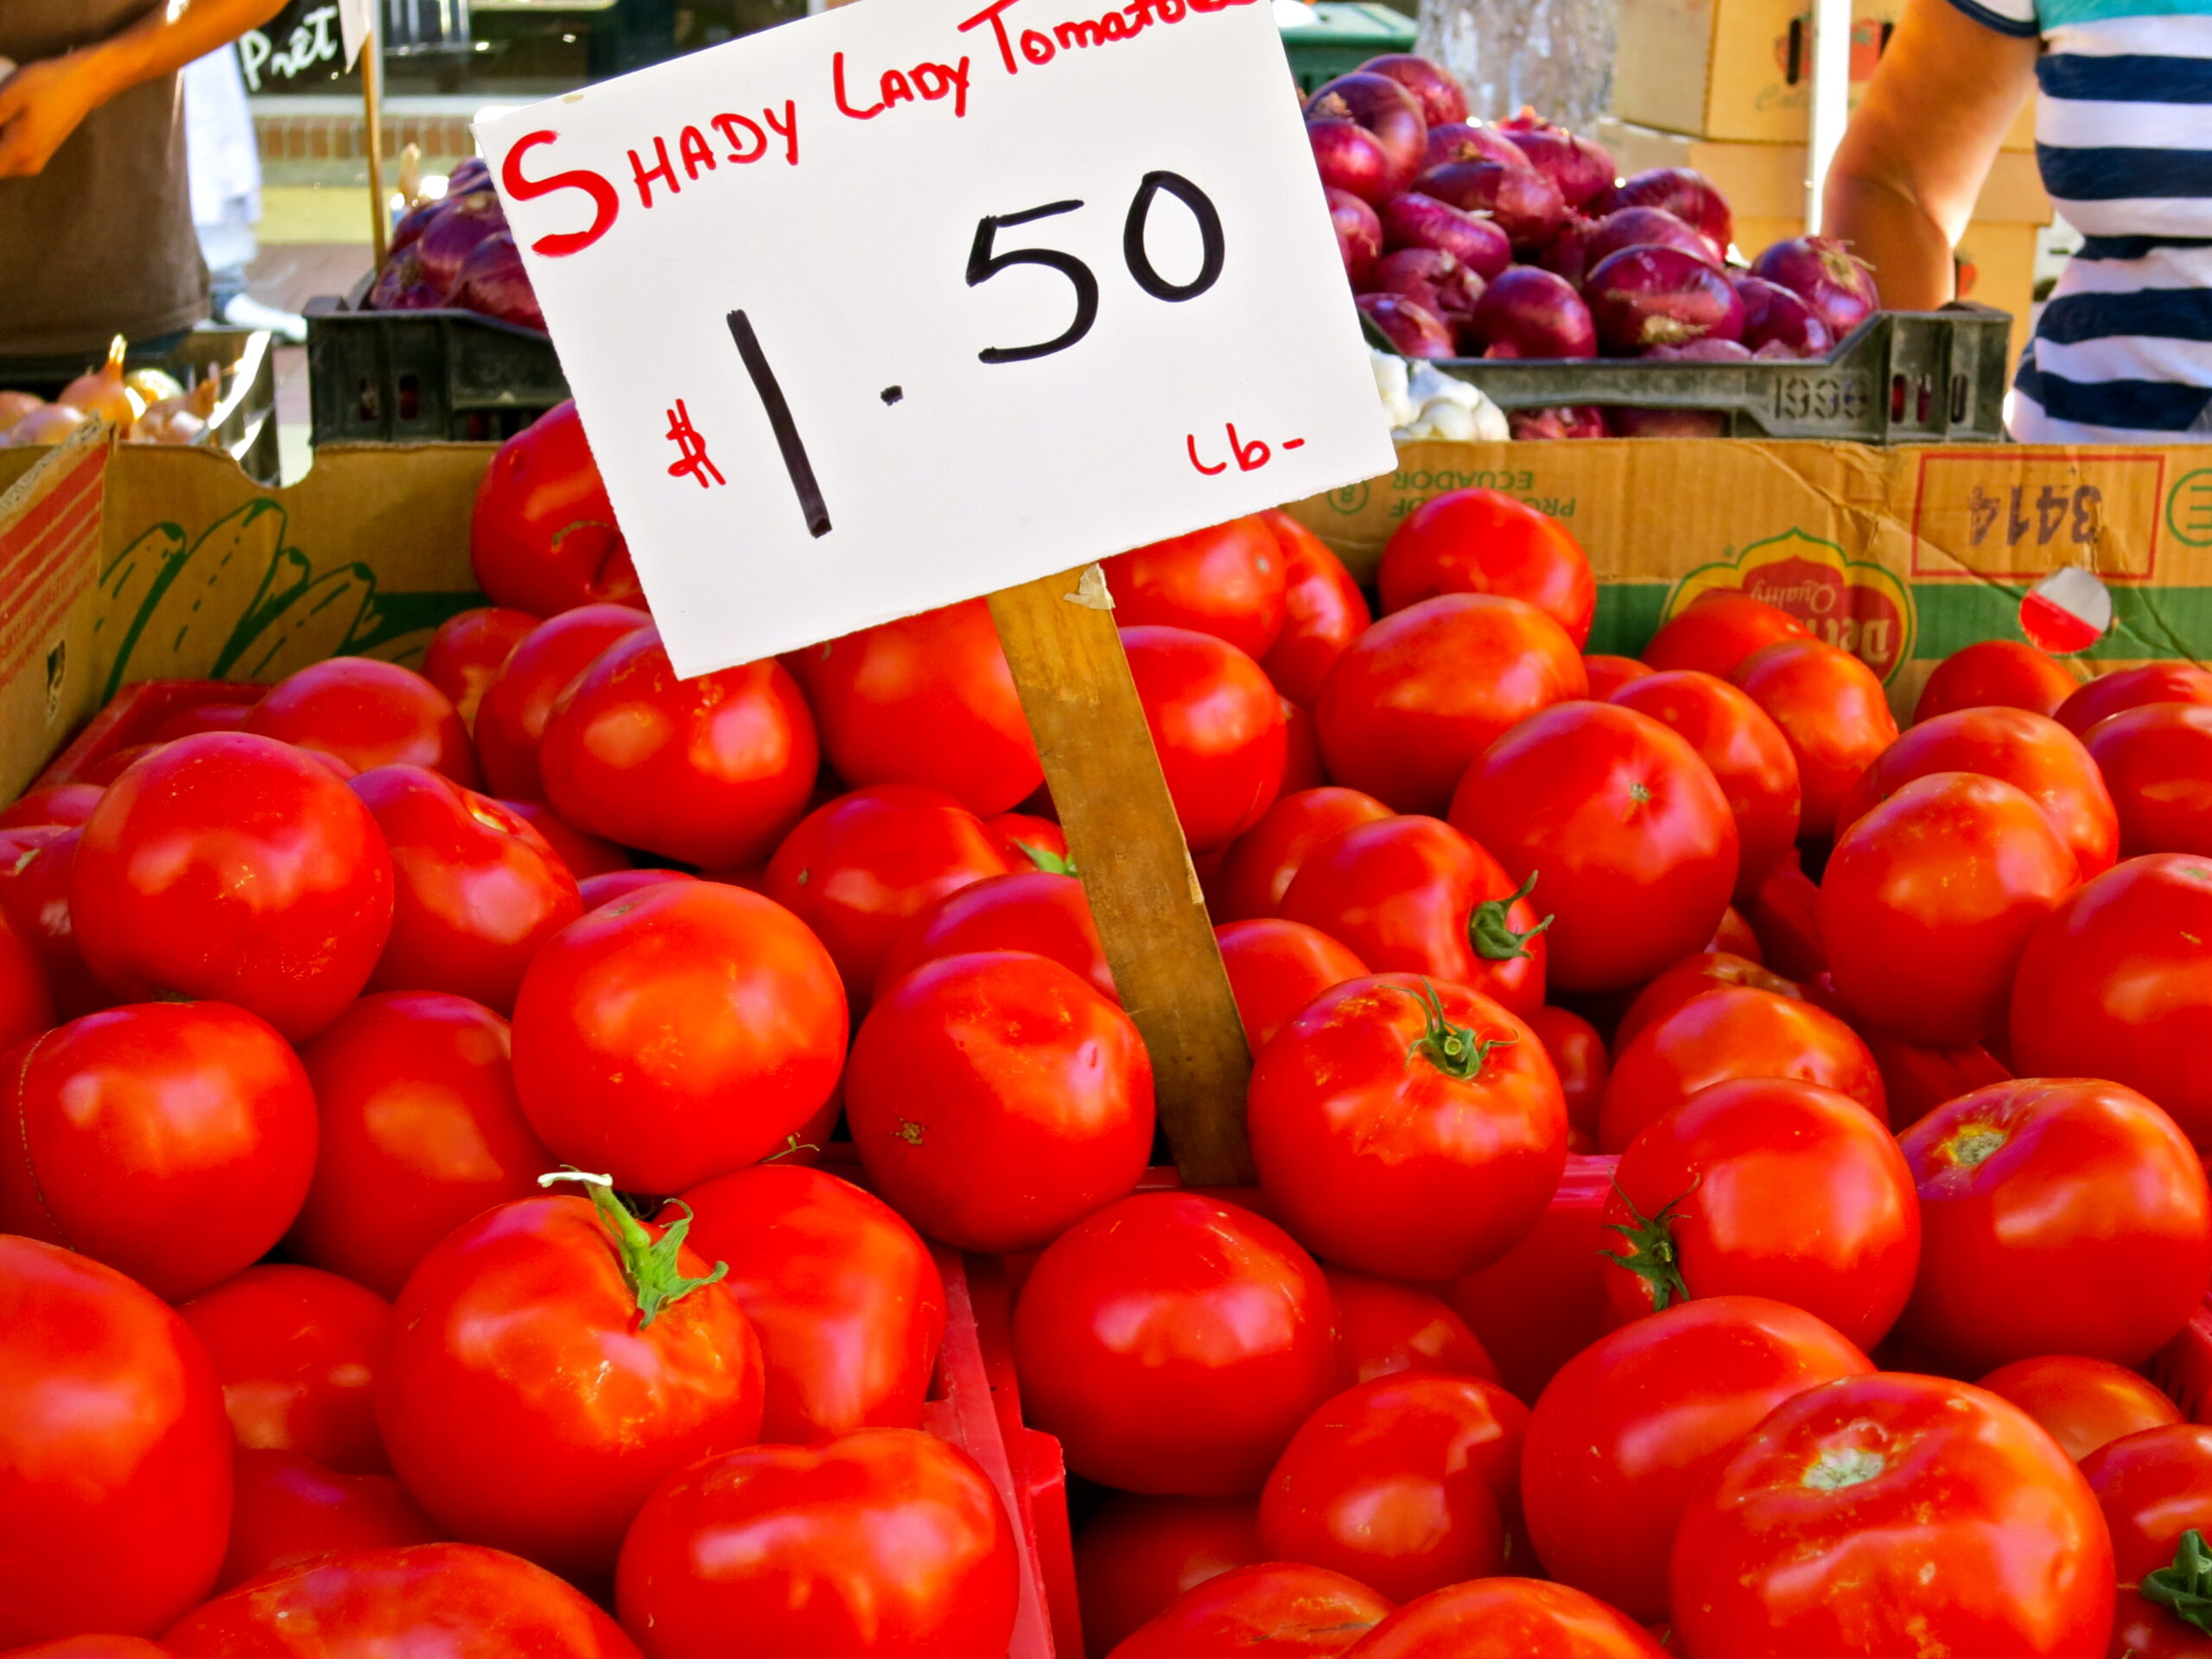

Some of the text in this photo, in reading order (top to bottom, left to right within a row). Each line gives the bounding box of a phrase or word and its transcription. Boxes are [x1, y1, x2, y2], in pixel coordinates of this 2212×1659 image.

[503, 114, 798, 257] SHADY
[834, 53, 969, 119] LADY
[1392, 471, 1534, 490] ECUADOR
[1968, 485, 2102, 546] 3414
